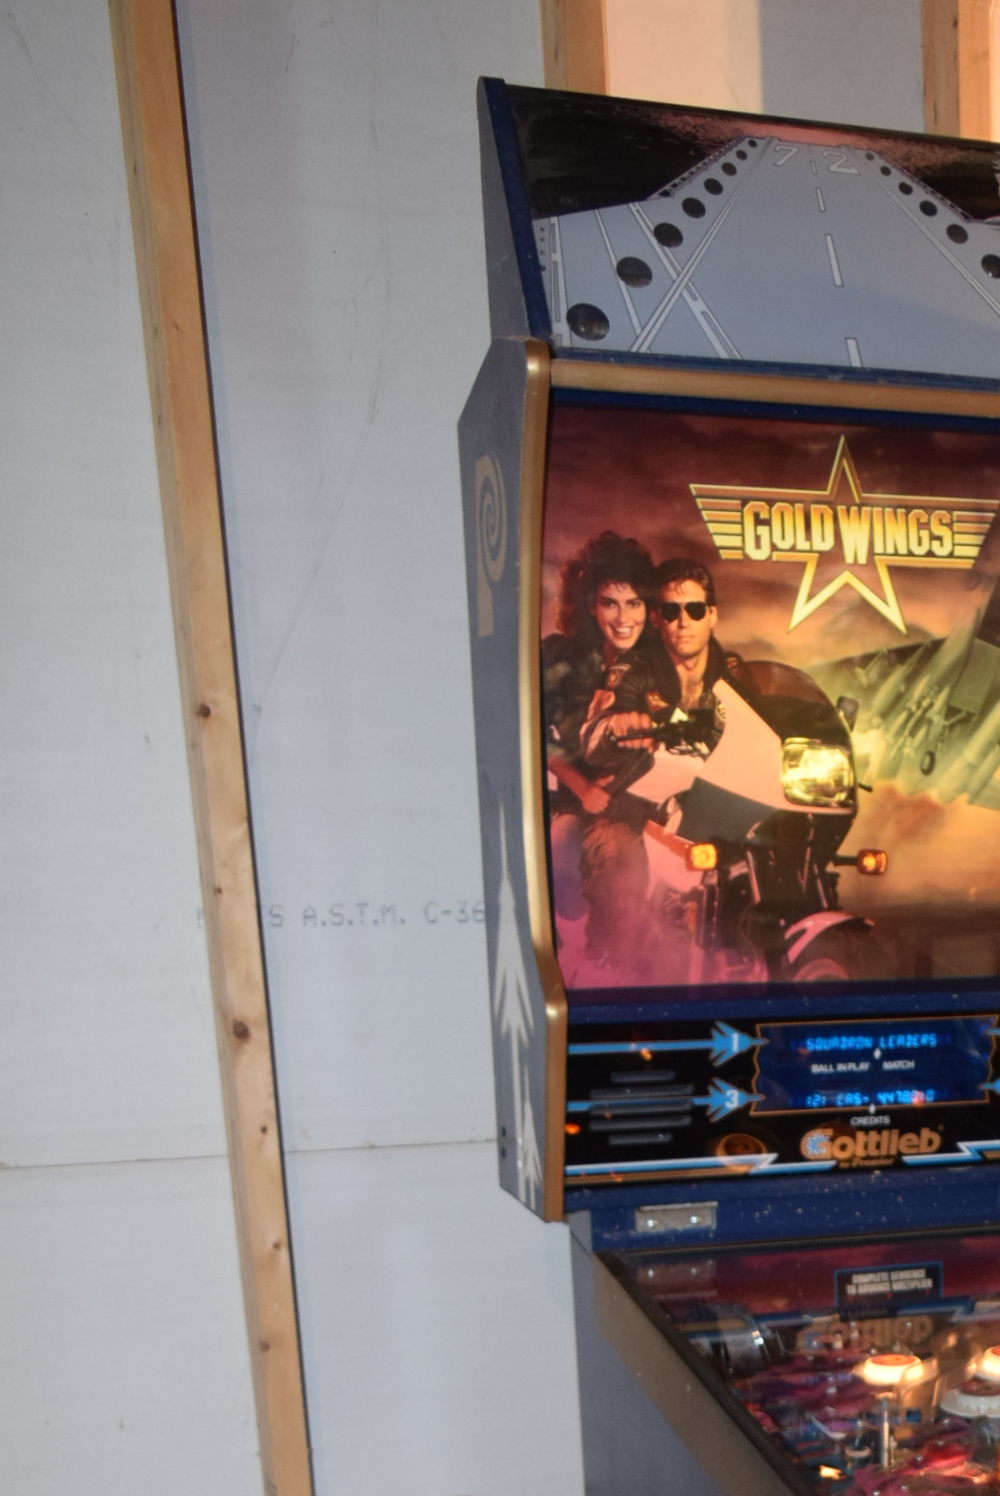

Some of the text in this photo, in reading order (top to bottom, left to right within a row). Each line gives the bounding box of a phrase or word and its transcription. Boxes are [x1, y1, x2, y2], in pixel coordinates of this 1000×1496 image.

[774, 145, 860, 175] 7 2
[743, 501, 953, 565] GOLD WINGS
[731, 1032, 739, 1053] 1
[811, 1062, 835, 1074] BALL
[848, 1061, 870, 1072] PLAY
[882, 1060, 915, 1070] MATCH
[725, 1089, 739, 1108] 3
[851, 1115, 890, 1126] CREDITS
[800, 1127, 942, 1160] Gottlieb
